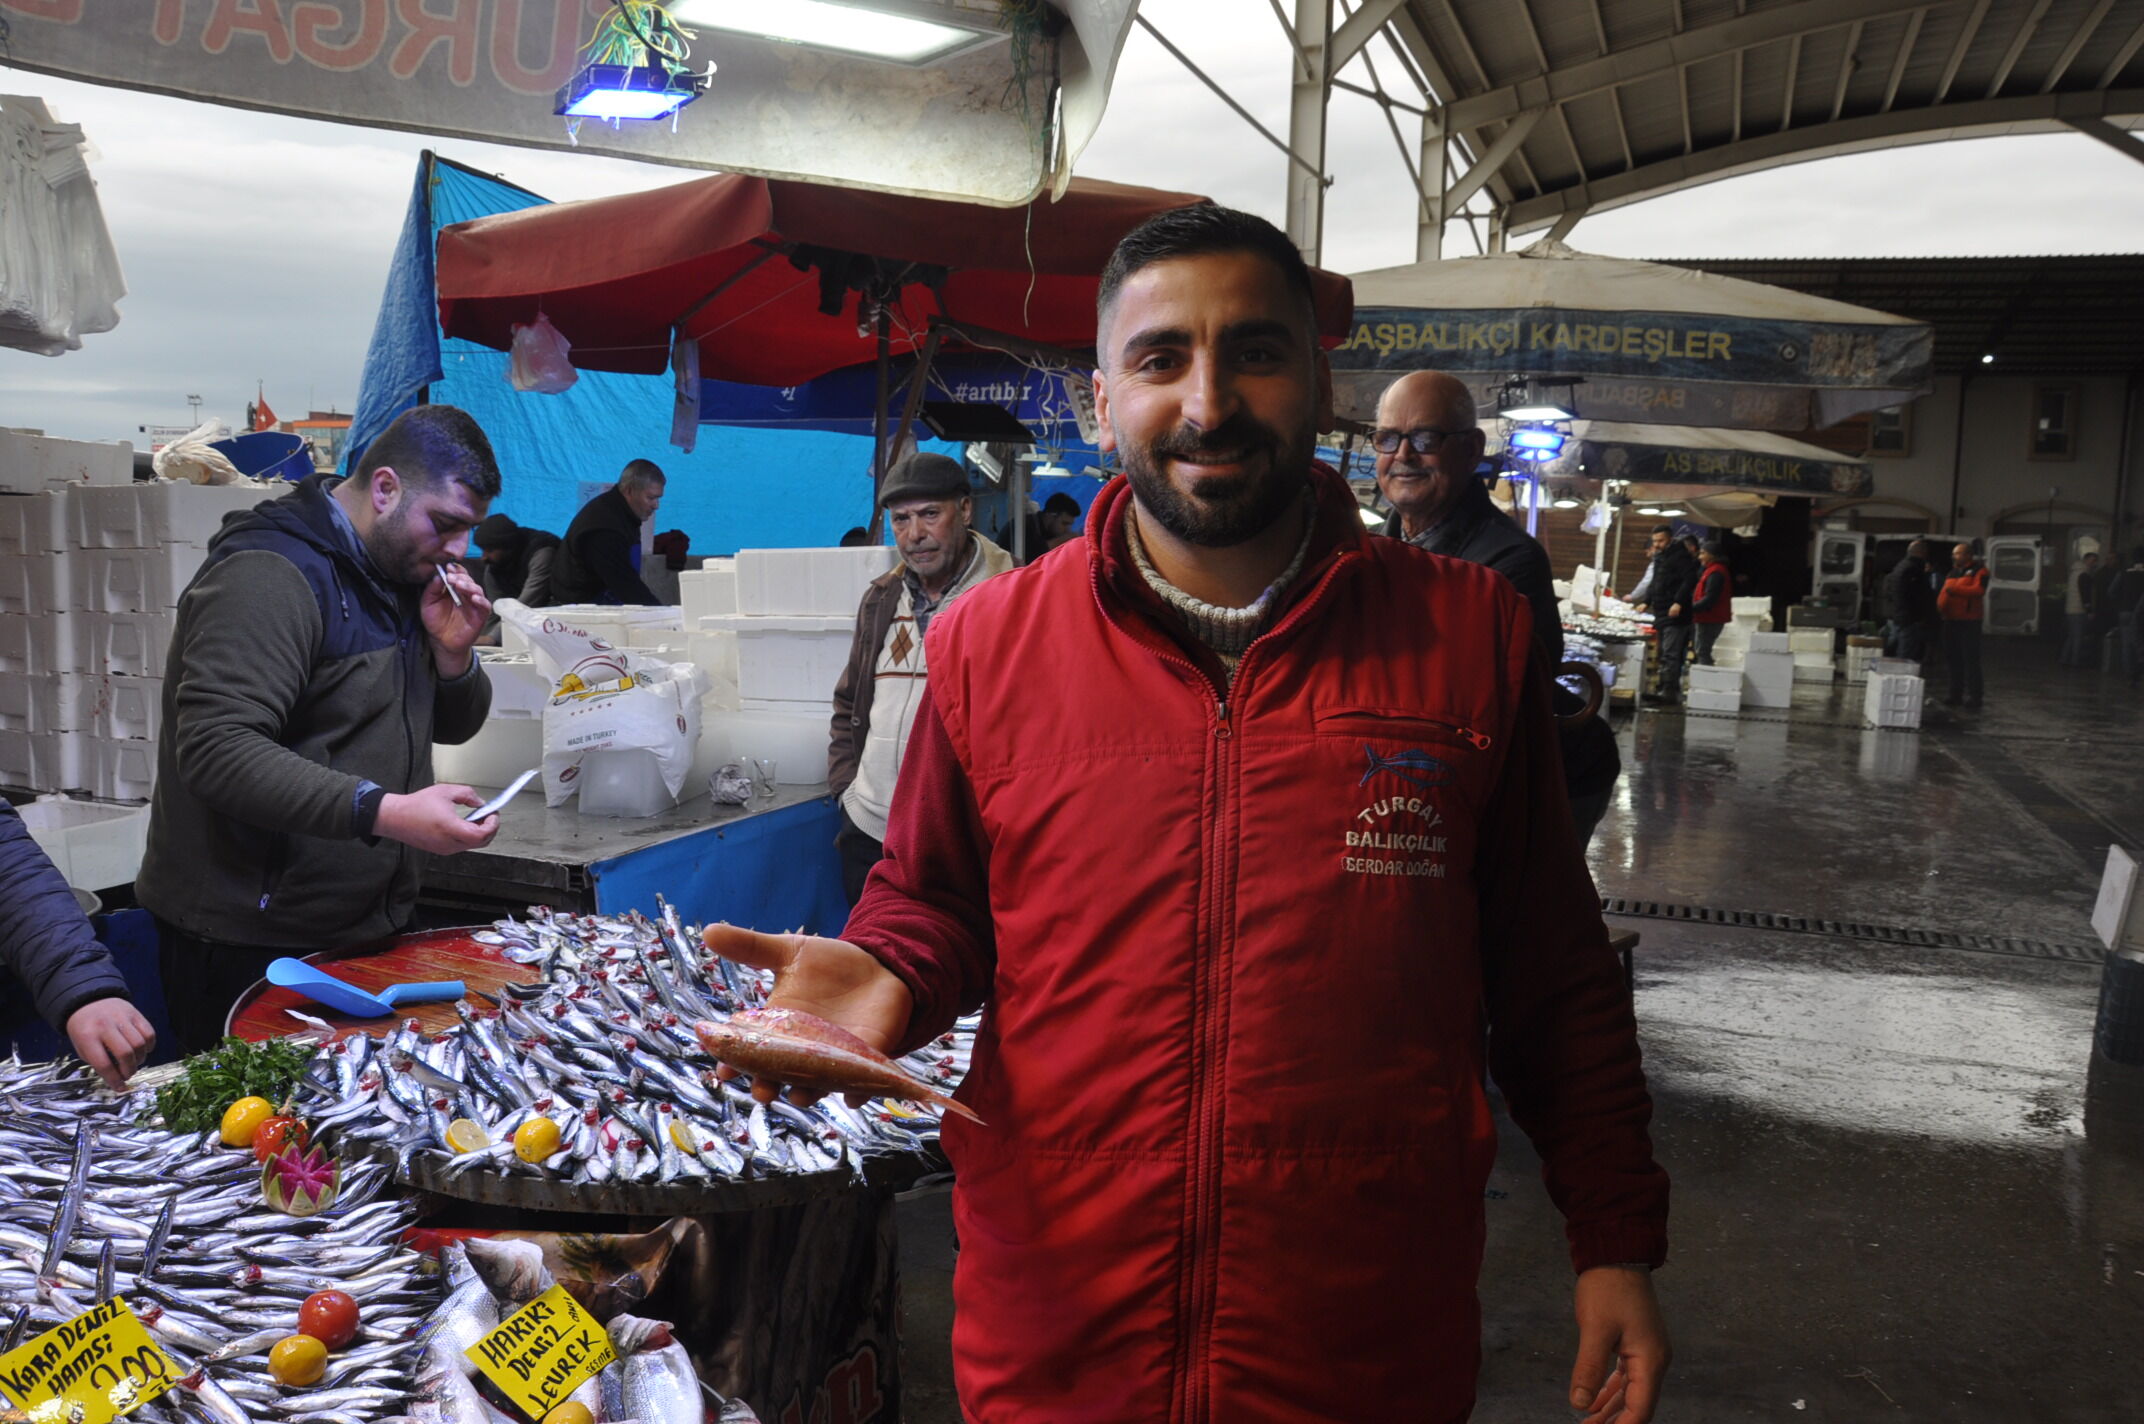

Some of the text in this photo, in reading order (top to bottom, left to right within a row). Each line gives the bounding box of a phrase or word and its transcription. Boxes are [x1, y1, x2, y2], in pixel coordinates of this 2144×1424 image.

[1530, 322, 1732, 362] KARDEŞLER
[1697, 453, 1802, 482] BALIKÇILIK
[567, 735, 584, 746] MADE
[592, 730, 617, 741] TURKEY
[1357, 796, 1443, 828] TURGAY
[1345, 831, 1448, 853] BALIKÇILIK
[1345, 857, 1446, 878] SERDAR DOĞAN
[0, 1343, 62, 1402] KARA
[527, 1329, 602, 1412] LEVREK
